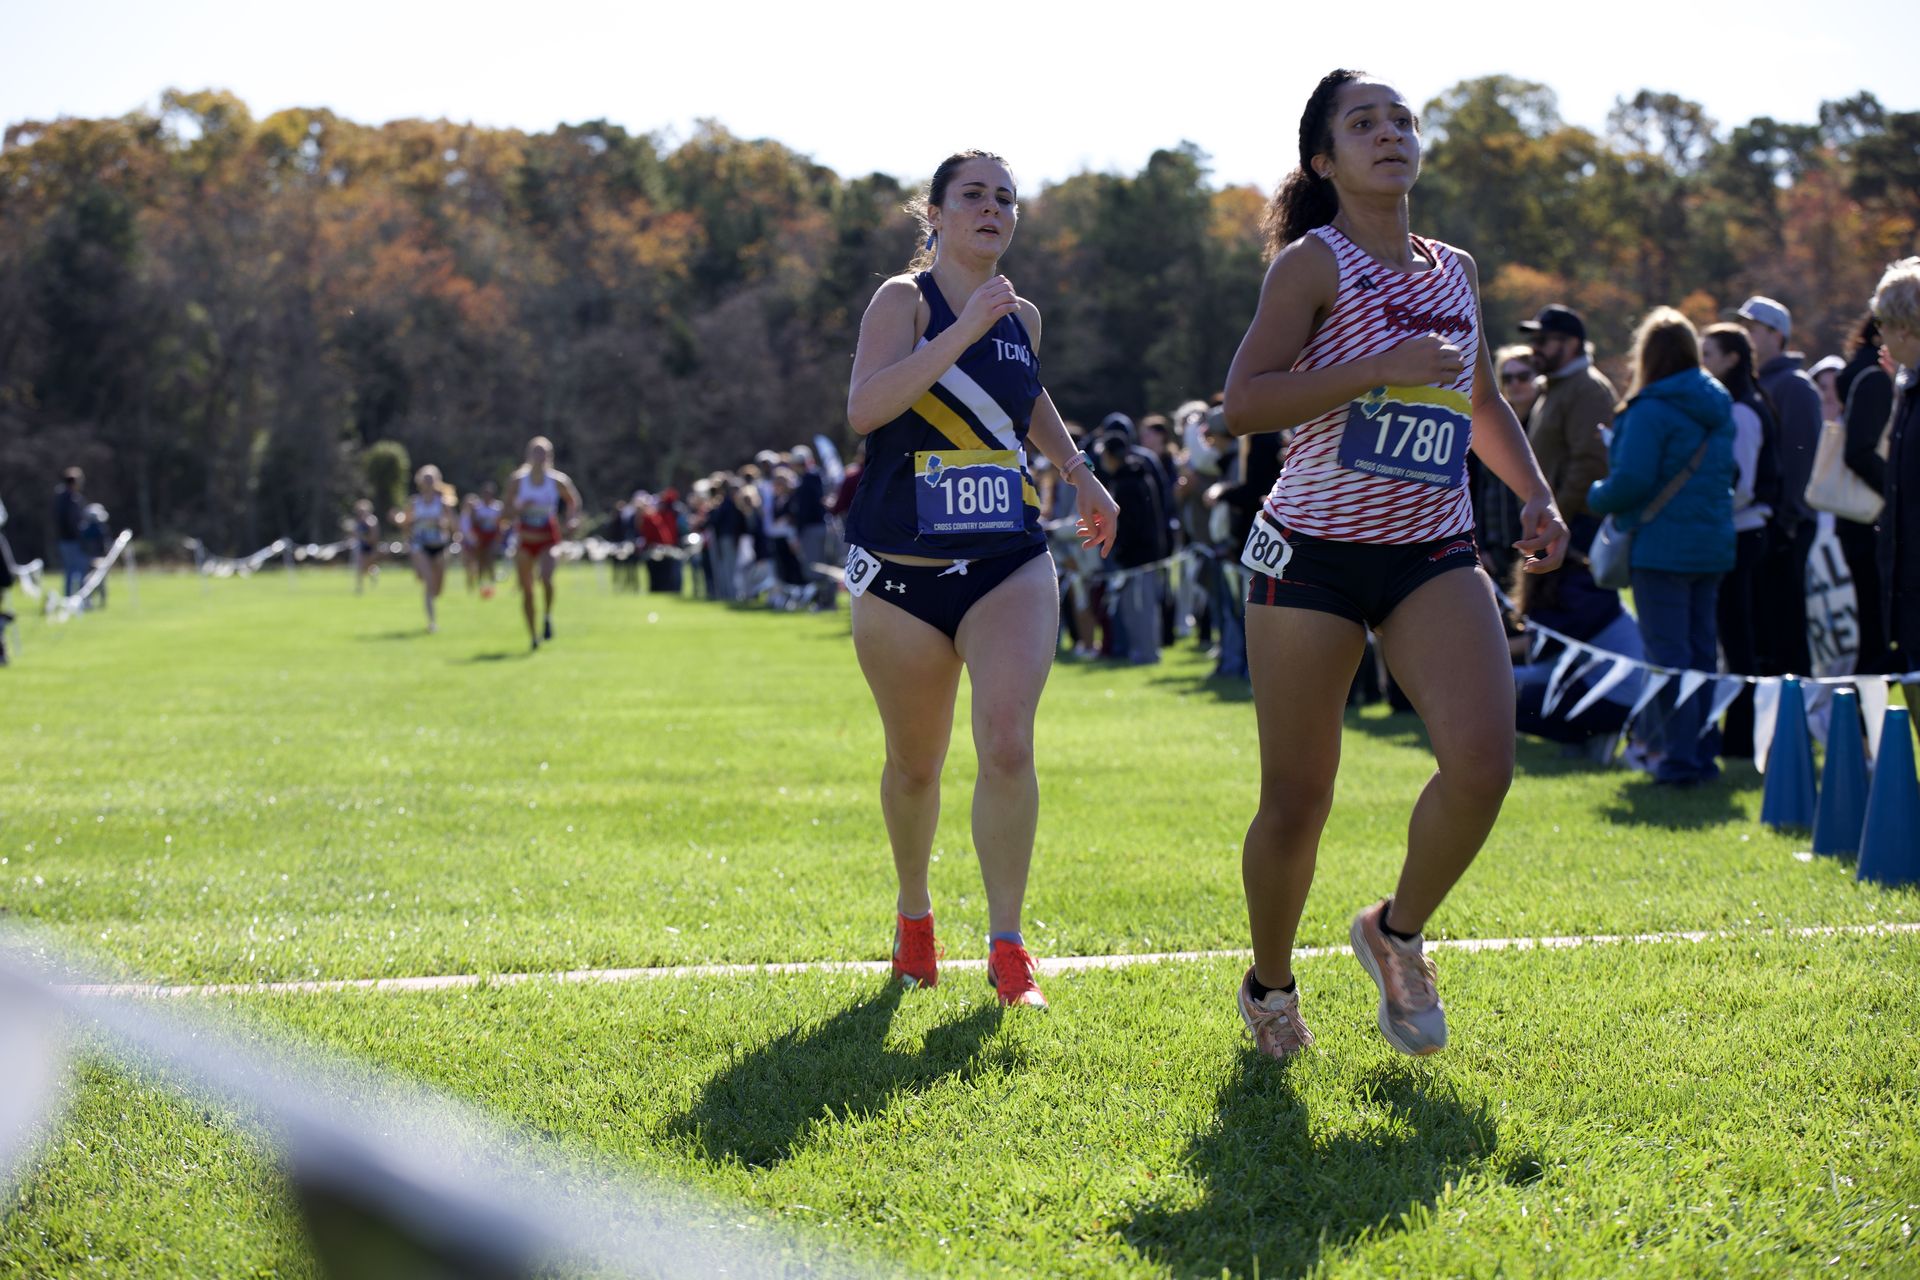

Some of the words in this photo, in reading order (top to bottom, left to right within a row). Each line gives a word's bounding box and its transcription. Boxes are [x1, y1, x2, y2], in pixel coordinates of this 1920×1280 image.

[1374, 412, 1455, 465] 1780
[1354, 459, 1376, 472] CROSS
[1376, 463, 1405, 477] COUNTRY
[1405, 468, 1452, 485] CHAMPIONSHIPS
[940, 476, 1010, 515] 1809
[933, 523, 952, 531] CROSS
[953, 522, 977, 530] COUNTRY
[978, 520, 1014, 529] CHAMPIONSHIPS
